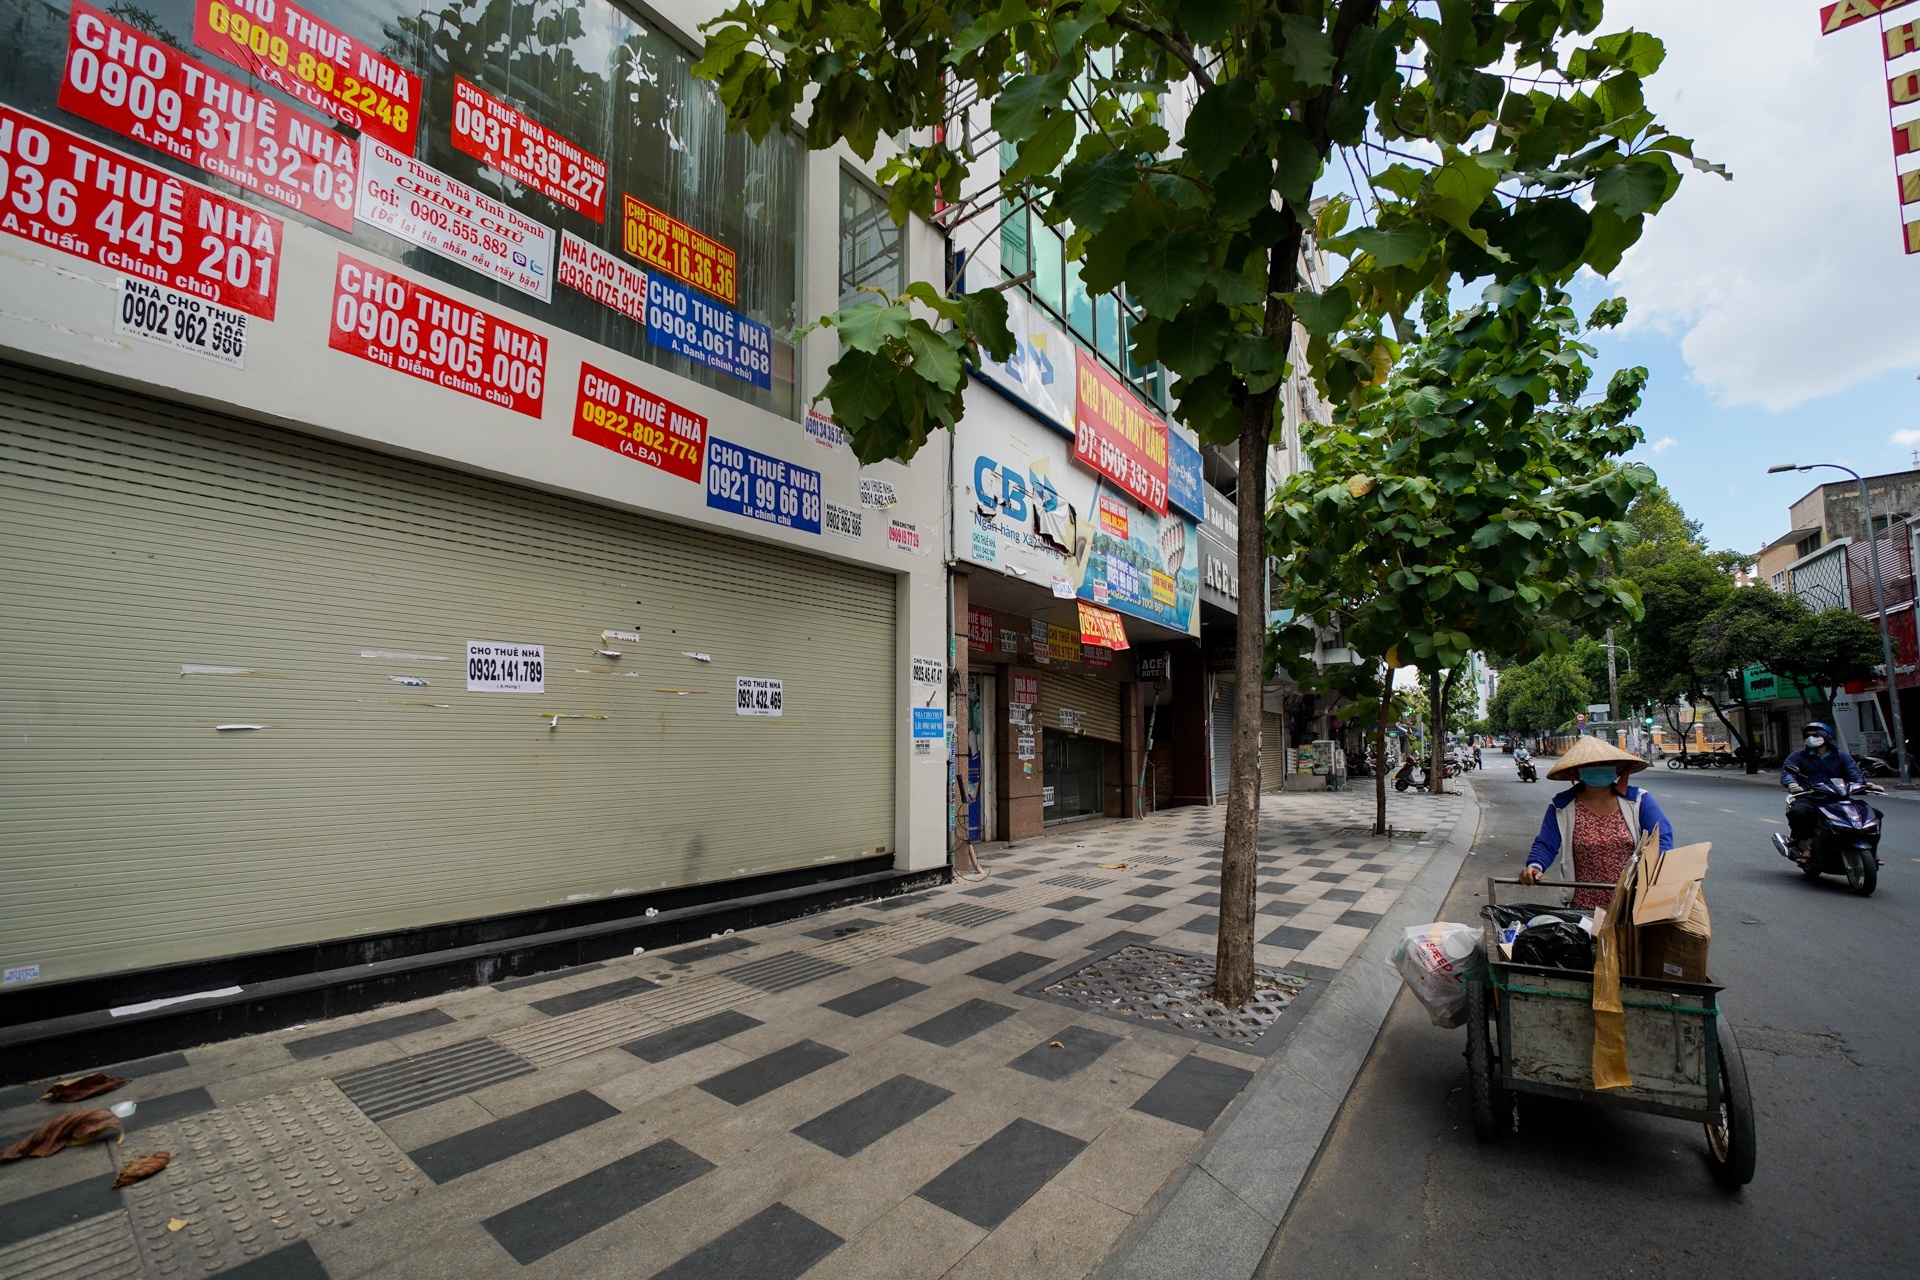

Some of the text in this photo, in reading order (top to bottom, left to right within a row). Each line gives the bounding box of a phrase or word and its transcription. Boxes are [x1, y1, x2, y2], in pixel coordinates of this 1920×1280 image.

[208, 2, 409, 133] 0909.89.2248
[285, 7, 352, 68] THUÊ
[359, 58, 411, 102] NHÀ
[75, 13, 354, 173] CHO THUÊ NHÀ
[70, 48, 354, 211] 0909.31.32.03
[455, 101, 604, 206] 0931.339.227
[456, 81, 605, 178] CHO THUÊ NHÀ CHÍNH CHỦ
[1885, 18, 1920, 253] HOT
[67, 144, 185, 217] THUÊ
[197, 198, 276, 256] NHÀ
[131, 122, 303, 211] A.Phú (chính chủ)
[375, 145, 545, 239] Cho Thuê Nhà Kinh Doanh
[483, 152, 580, 212] A. NGHĨA (MTG)
[368, 180, 508, 259] Gọi: 0902.555.882
[396, 176, 525, 243] CHÍNH CHỦ
[628, 203, 734, 269] CHO THUÊ NHÀ CHÍNH CHỦ
[2, 213, 221, 303] A.Tuấn (chính chủ)
[95, 200, 185, 266] 445
[197, 236, 273, 298] 201
[401, 218, 416, 233] lại
[422, 229, 438, 244] tin
[442, 240, 467, 257] nhắn
[519, 273, 540, 291] bận)
[562, 238, 647, 300] NHÀ CHO THUÊ
[628, 220, 734, 305] 0922.16.36.36
[122, 293, 170, 335] 0902
[174, 309, 208, 347] 962
[125, 279, 247, 329] NHÀ CHO THUÊ
[341, 265, 544, 367] CHO THUÊ NHÀ
[649, 281, 771, 352] CHO THUÊ NHÀ
[335, 294, 542, 400] 0906.905.006
[649, 307, 771, 375] 0908.061.068
[683, 342, 707, 363] Danh
[708, 354, 735, 376] (chính
[735, 365, 753, 382] chủ)
[367, 343, 514, 409] Chị Diễm (chính chủ)
[583, 373, 702, 444] CHO THUÊ NHÀ
[581, 400, 699, 465] 0922.802.774
[1080, 365, 1166, 469] CHO THUÊ MẶT BẰNG
[619, 439, 663, 467] (A.BA)
[710, 443, 819, 494] CHO THUÊ NHÀ
[1078, 420, 1097, 462] ĐT:
[1100, 437, 1127, 482] 0909
[1129, 460, 1148, 497] 335
[1150, 474, 1165, 509] 757
[709, 464, 820, 523] 0921 99 66 88
[742, 504, 792, 527] LH chính chủ
[826, 504, 838, 513] NHÀ
[838, 507, 848, 516] CHO
[1211, 507, 1224, 532] SAO
[1001, 522, 1020, 544] hàng
[1207, 554, 1228, 594] ACE
[469, 658, 542, 682] 0932.141.789
[470, 647, 541, 658] CHO THUÊ NHÀ
[753, 680, 768, 688] THUÊ
[769, 681, 781, 689] NHÀ
[1142, 659, 1163, 670] ACE
